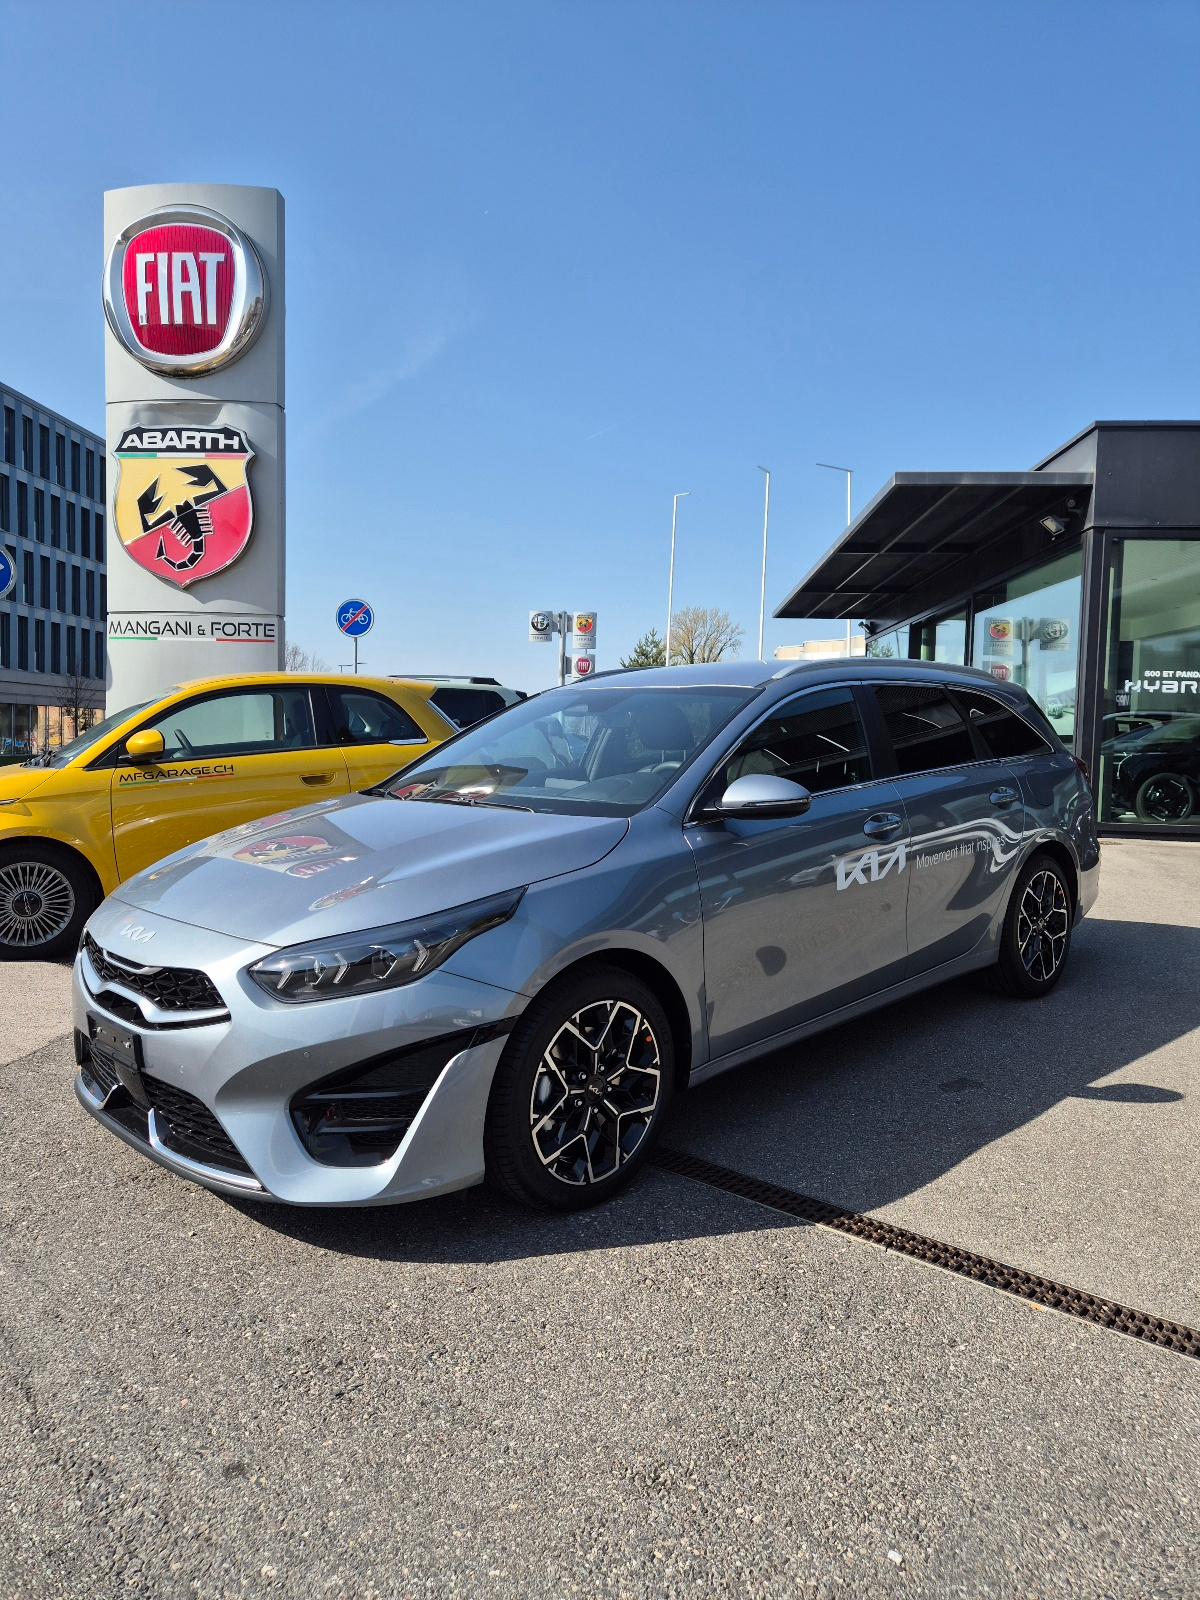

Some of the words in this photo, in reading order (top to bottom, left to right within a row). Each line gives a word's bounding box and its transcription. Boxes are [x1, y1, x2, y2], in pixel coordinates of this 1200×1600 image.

[136, 252, 225, 325] FIAT
[121, 430, 240, 450] ABARTH
[109, 620, 192, 635] MANGANI
[197, 624, 206, 635] &
[211, 621, 275, 637] FORTE
[1124, 680, 1200, 694] HYBR
[119, 764, 234, 782] MFGARAGE.CH
[836, 844, 907, 891] KIA
[916, 848, 959, 870] Movement
[959, 841, 975, 857] that
